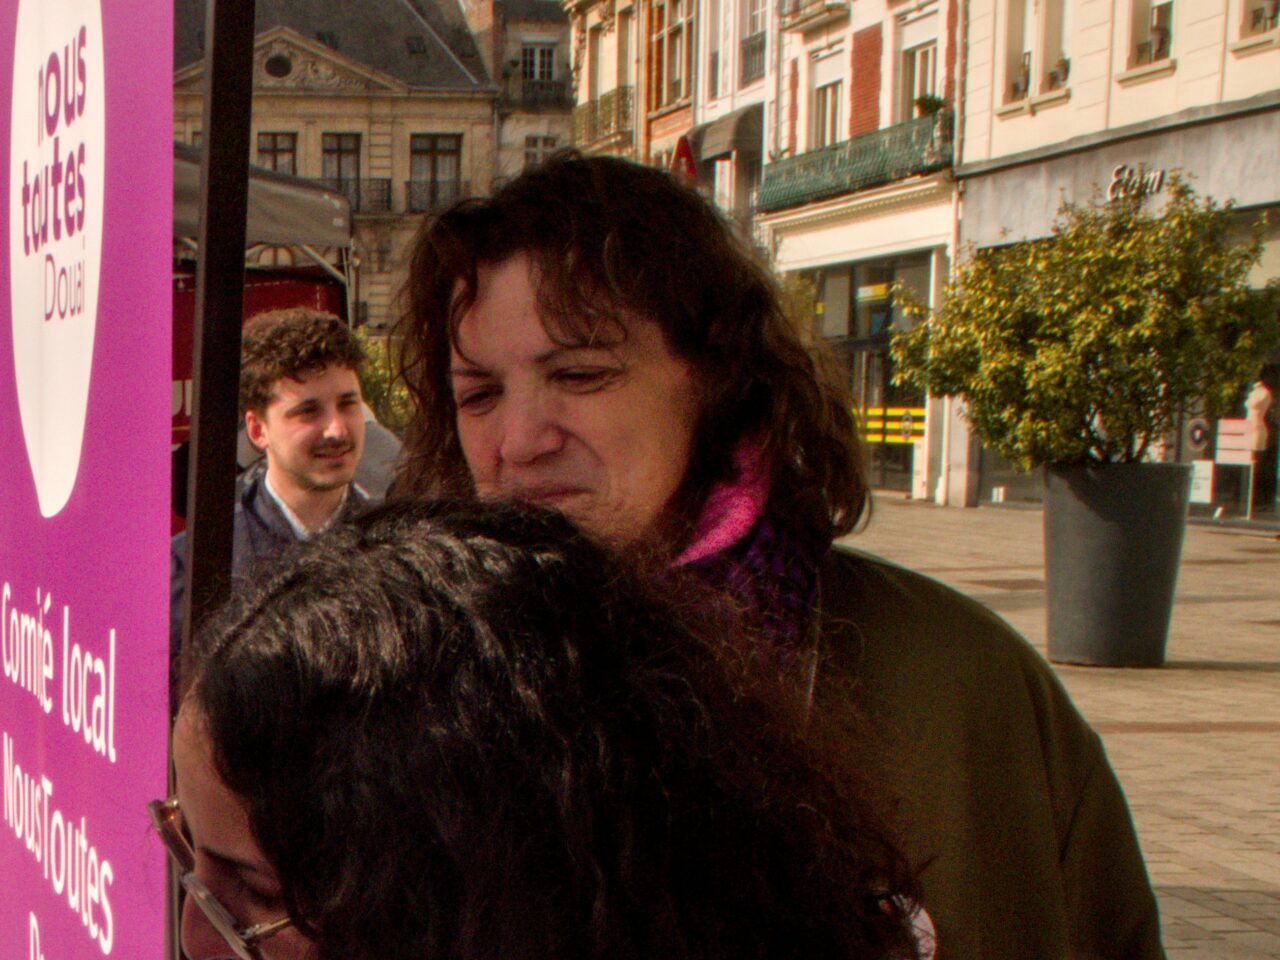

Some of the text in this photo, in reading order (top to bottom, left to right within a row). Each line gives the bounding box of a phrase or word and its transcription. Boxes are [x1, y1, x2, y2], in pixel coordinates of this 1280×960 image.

[38, 25, 86, 147] nous
[22, 136, 85, 256] toutes
[44, 236, 85, 321] Douai
[63, 605, 116, 763] local
[3, 731, 113, 955] NousToutes
